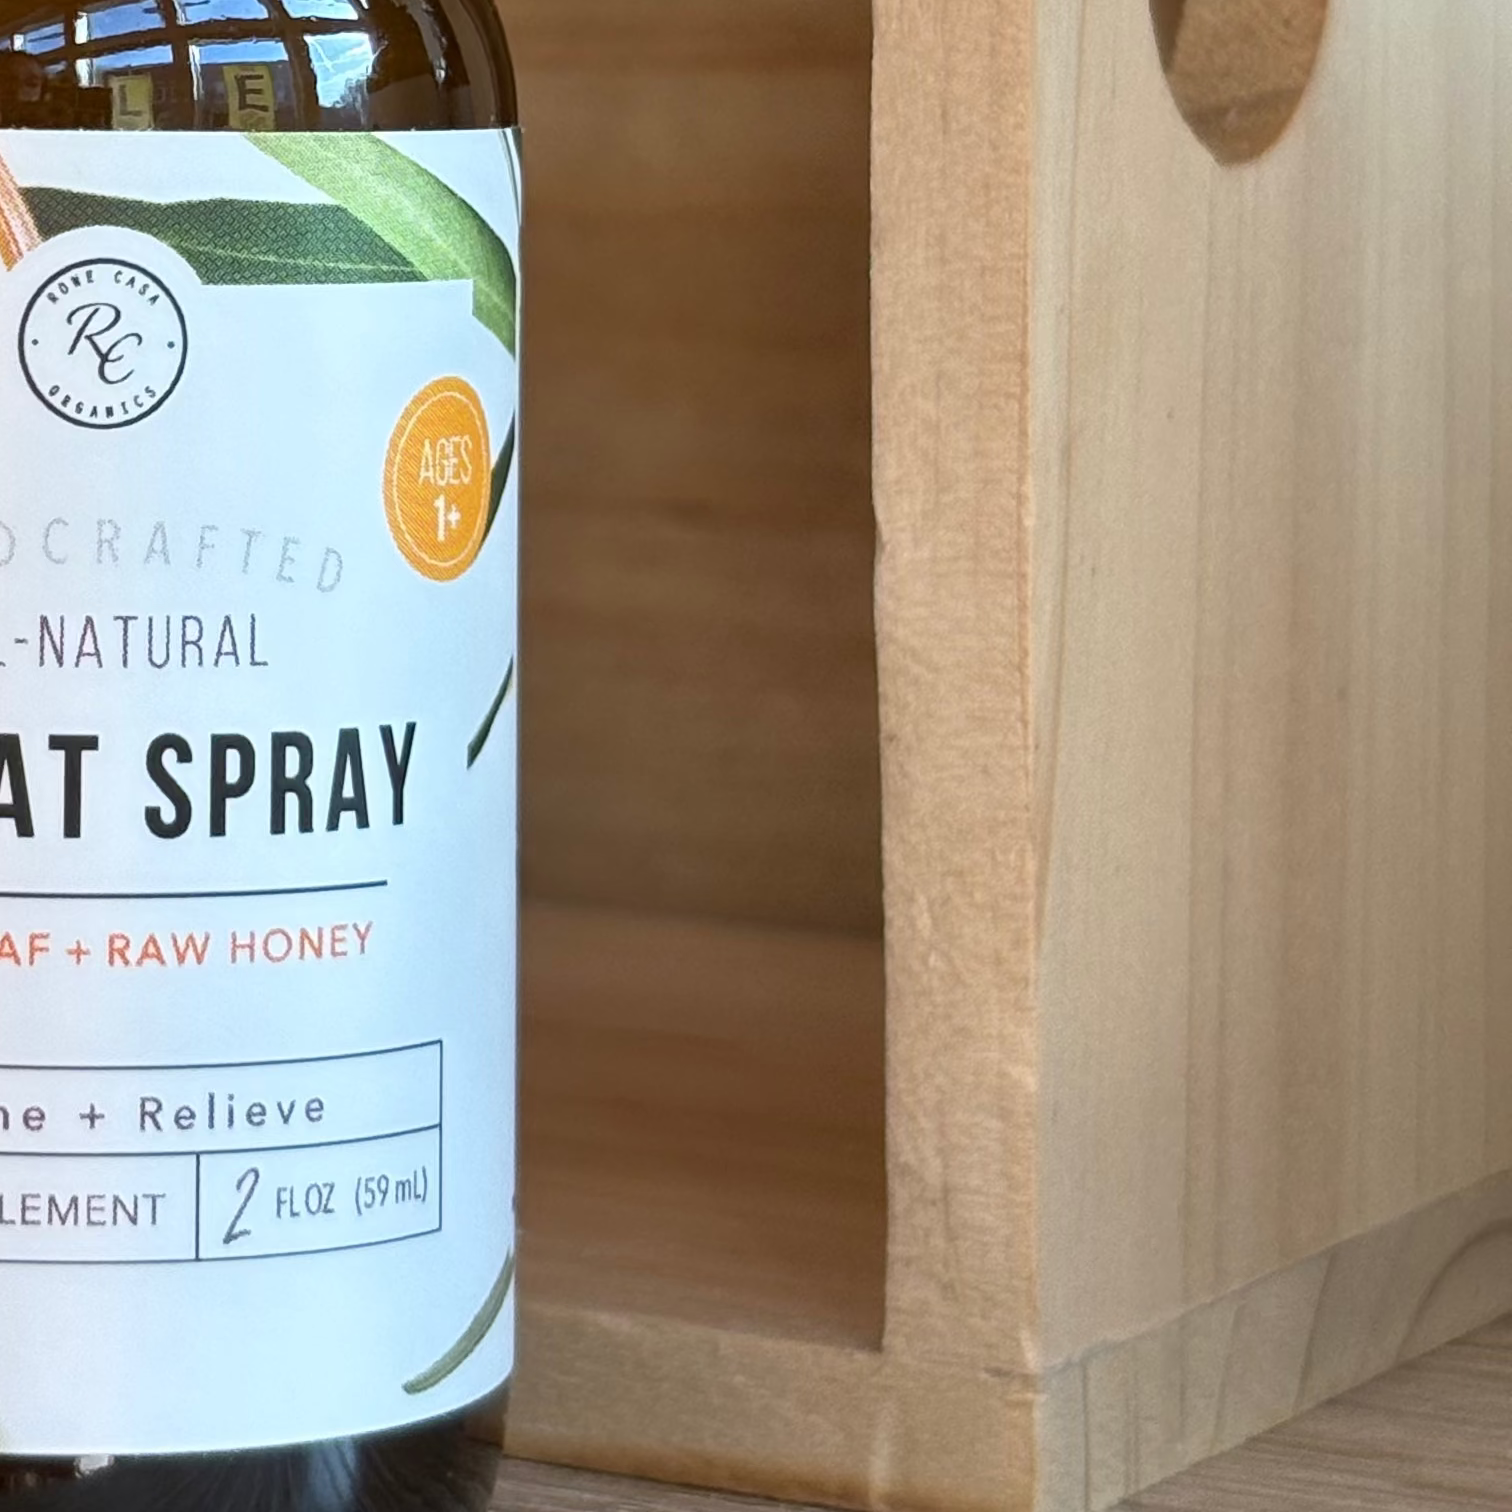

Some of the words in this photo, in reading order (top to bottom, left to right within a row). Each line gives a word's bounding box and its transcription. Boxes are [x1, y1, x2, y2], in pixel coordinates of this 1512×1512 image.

[46, 269, 95, 305] RONE
[113, 270, 161, 307] CASA
[48, 384, 157, 419] ORGANICS
[418, 434, 473, 486] AGES
[432, 493, 462, 542] 1+
[144, 721, 417, 840] SPRAY
[107, 932, 211, 967] RAW
[230, 922, 374, 964] HONEY
[139, 1092, 326, 1133] Relieve
[222, 1166, 261, 1246] 2
